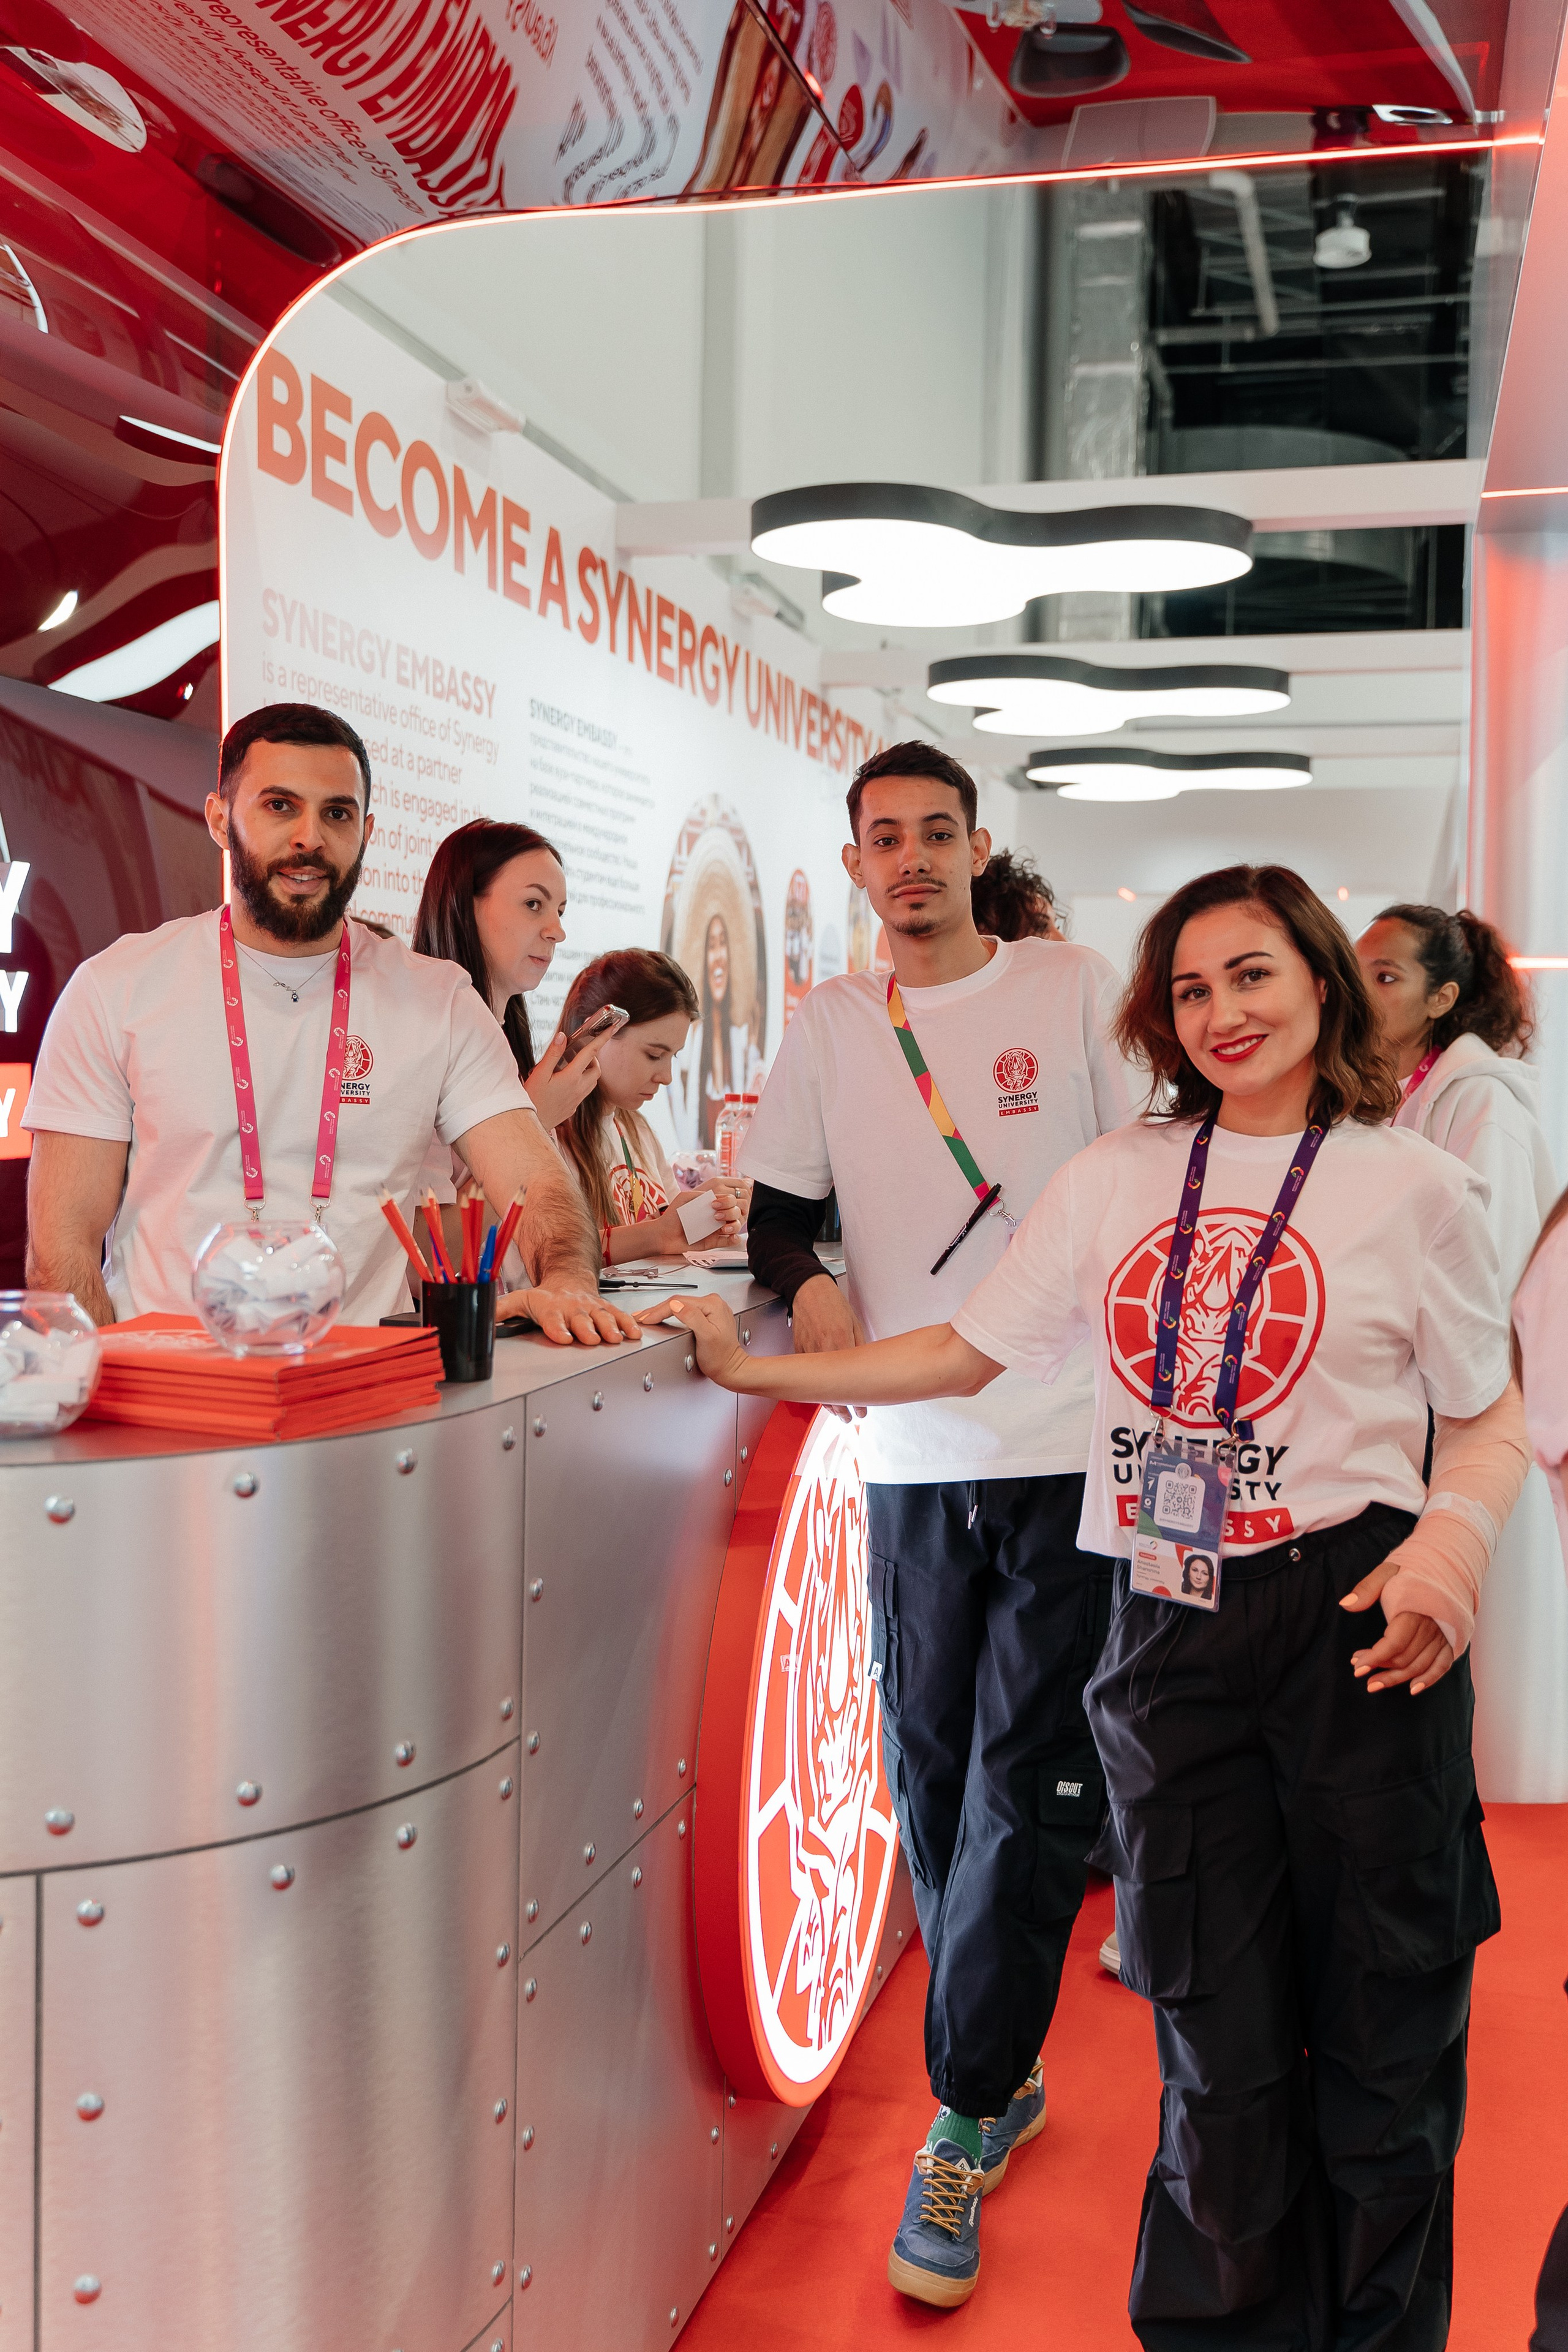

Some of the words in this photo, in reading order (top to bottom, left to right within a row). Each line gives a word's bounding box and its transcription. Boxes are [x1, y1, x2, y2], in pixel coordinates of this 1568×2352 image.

[257, 348, 530, 610] BECOME
[538, 526, 571, 631] A
[577, 546, 739, 714] SYNERGY
[745, 649, 873, 775] UNIVERSITY
[262, 588, 391, 680] SYNERGY
[396, 644, 496, 718] EMBASSY
[262, 650, 274, 684] is
[278, 666, 287, 687] a
[291, 670, 397, 725] representative
[401, 704, 436, 737] office
[439, 717, 451, 742] of
[454, 720, 499, 764] Synergy
[393, 744, 403, 768] at
[408, 752, 414, 771] a
[418, 755, 463, 784] partner
[391, 780, 400, 809] is
[403, 791, 458, 826] engaged
[389, 824, 402, 851] of
[404, 826, 434, 859] joint
[384, 862, 410, 894] into
[413, 869, 426, 894] th
[341, 1082, 371, 1091] NERGY
[998, 1091, 1038, 1103] SYNERGY
[998, 1099, 1038, 1109] UNIVERSITY
[1000, 1106, 1038, 1116] EMBASSY
[1125, 1502, 1281, 1537] ESSY
